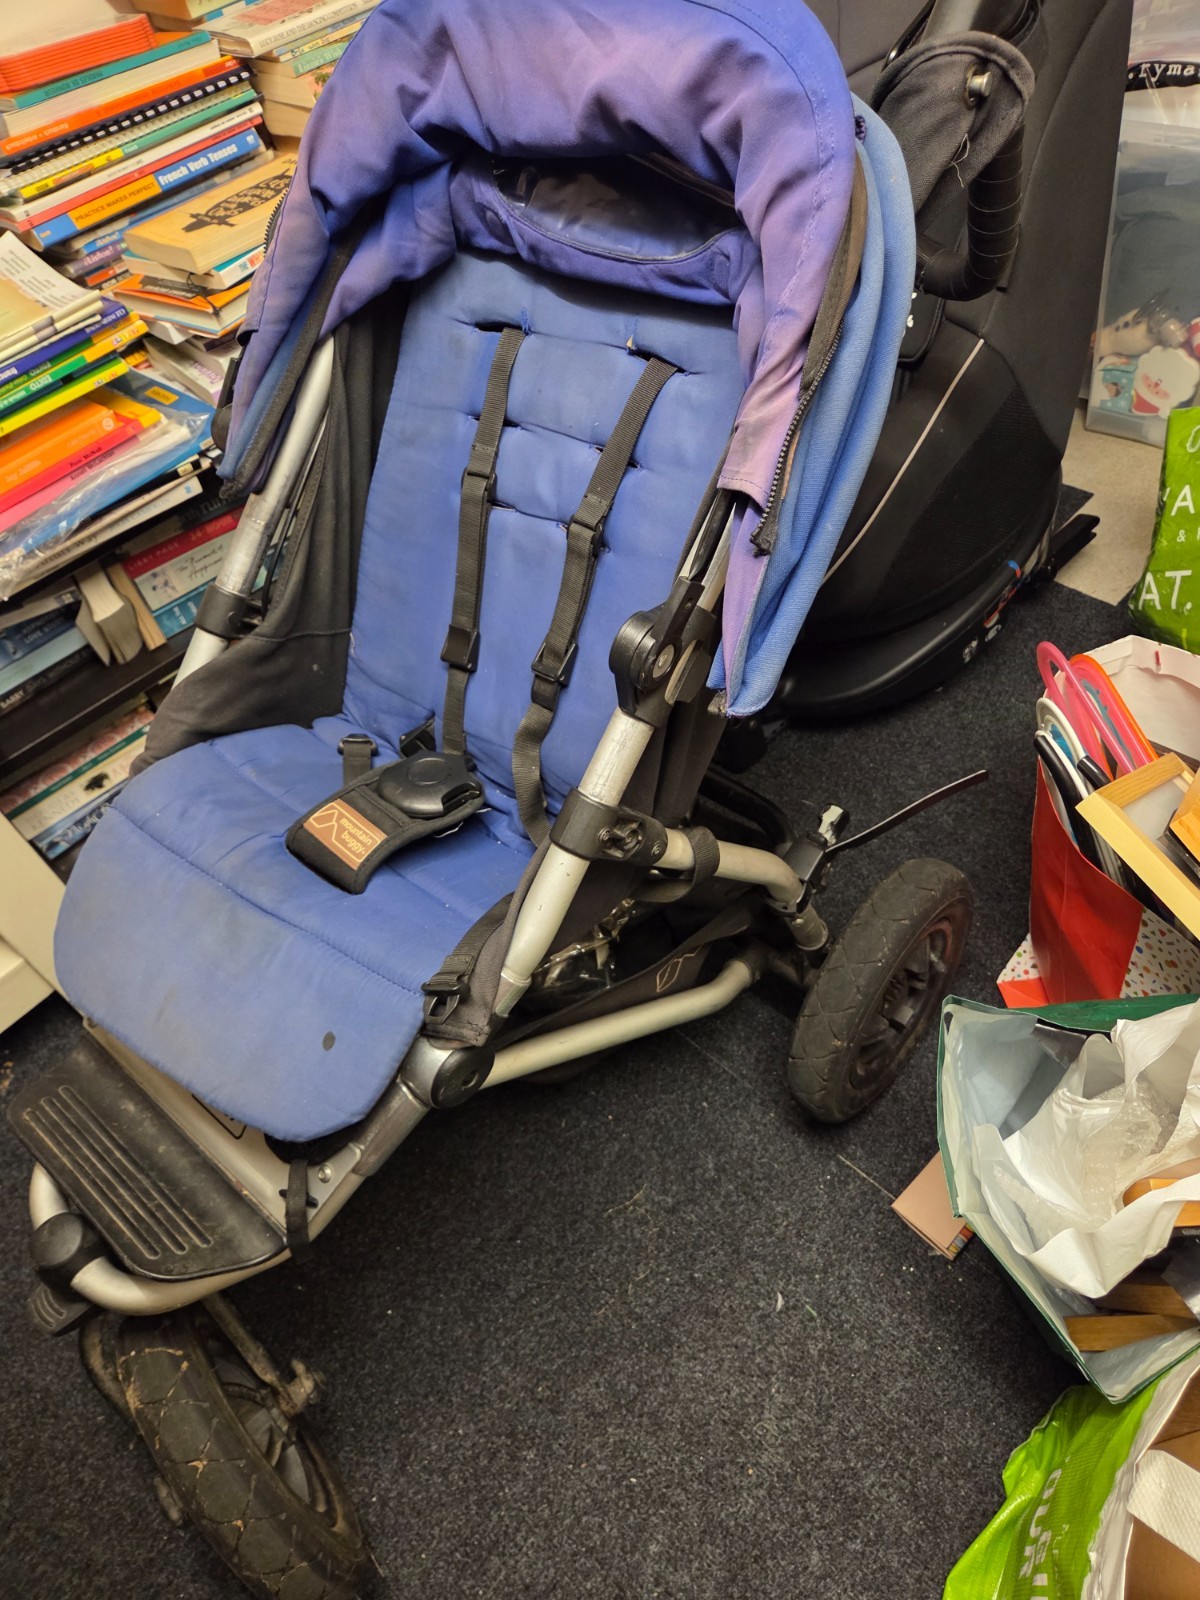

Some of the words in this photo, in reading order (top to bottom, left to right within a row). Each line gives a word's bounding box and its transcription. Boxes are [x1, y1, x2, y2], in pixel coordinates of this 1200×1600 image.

[158, 167, 189, 186] French
[187, 156, 209, 172] Verb
[207, 144, 238, 163] Tenses
[75, 206, 105, 223] PRACTICE
[105, 195, 128, 211] MAKES
[128, 182, 156, 199] PERFECT
[83, 245, 114, 266] ¡Listos!
[82, 447, 103, 460] McNab
[74, 535, 98, 550] Way
[129, 553, 155, 571] LIBBY
[156, 541, 179, 558] PAGE
[340, 817, 373, 846] mountain
[341, 830, 366, 853] buggy
